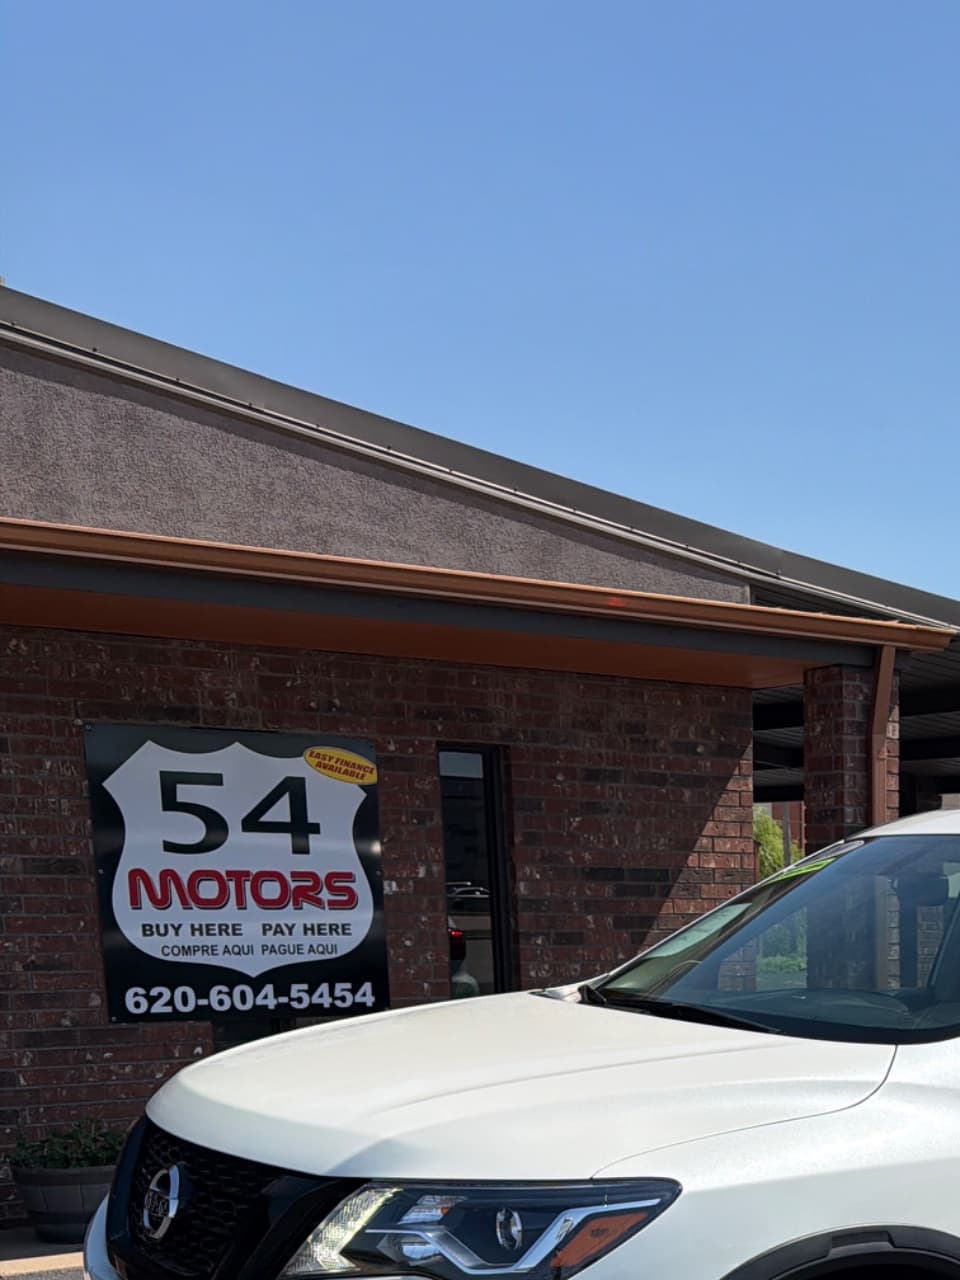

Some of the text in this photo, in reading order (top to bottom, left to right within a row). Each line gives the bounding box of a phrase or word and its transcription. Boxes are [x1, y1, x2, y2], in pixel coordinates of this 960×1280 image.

[308, 751, 375, 774] EASY FINANCE
[315, 760, 367, 780] AVAILABLE
[159, 770, 321, 855] 54
[127, 868, 358, 911] MOTORS
[141, 923, 353, 938] BUY HERE PAY HERE
[161, 943, 338, 957] COMPRE AQUI PAGUE AQUI
[124, 981, 375, 1014] 620-604-5454
